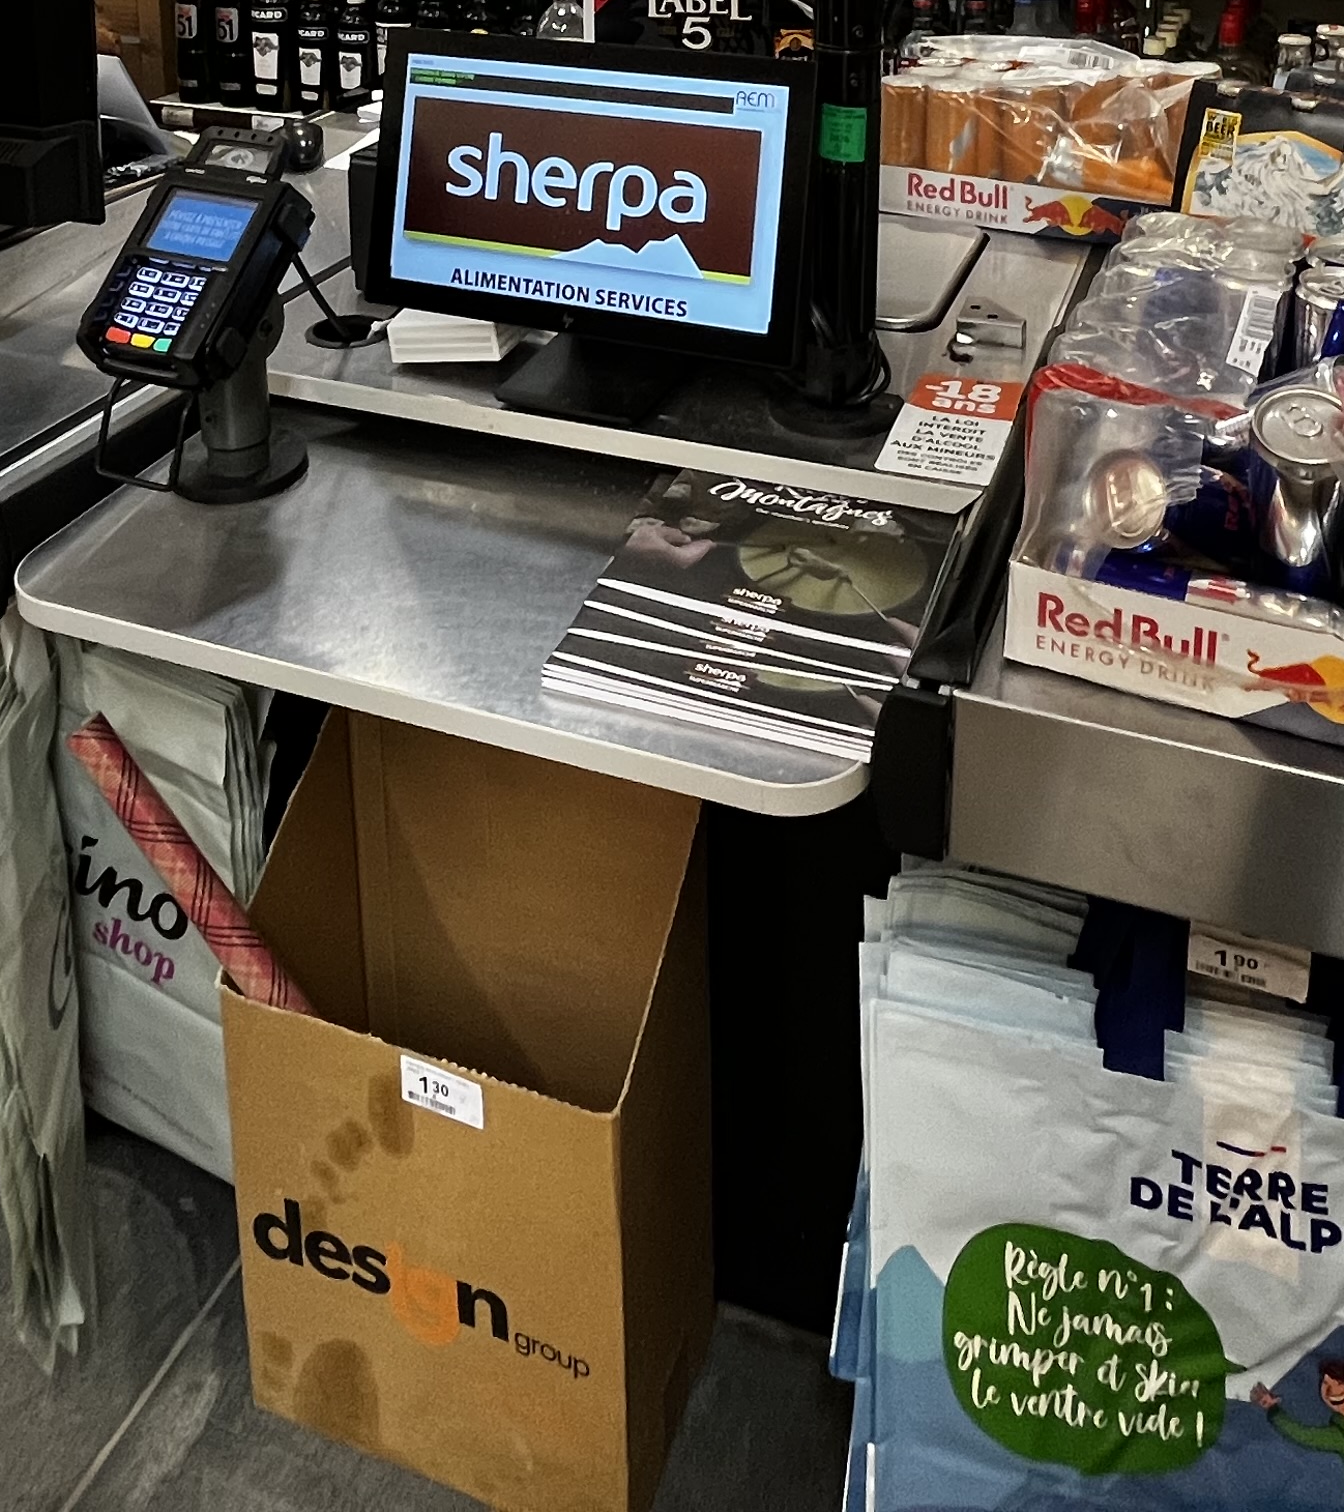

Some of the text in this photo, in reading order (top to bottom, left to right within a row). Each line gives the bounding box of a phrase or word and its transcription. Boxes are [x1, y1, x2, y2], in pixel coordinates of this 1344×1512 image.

[177, 16, 193, 38] 51
[252, 10, 282, 20] CARD
[218, 21, 234, 41] 51
[299, 29, 324, 38] CARD
[338, 32, 364, 42] CARD
[682, 16, 712, 50] 5
[1205, 121, 1236, 137] BEER
[446, 132, 708, 231] sherpa
[907, 172, 1009, 210] Red Bull
[906, 200, 1009, 225] ENERGY DRINK
[450, 268, 688, 318] ALIMENTATION SERVICES
[925, 380, 1002, 404] -18
[931, 396, 996, 414] ans
[918, 421, 987, 436] INTERDIT
[932, 415, 980, 427] LA LOI
[912, 435, 981, 451] D'ALCOOL
[916, 428, 984, 443] LA VENTE
[890, 439, 996, 461] AUX MINEURS
[732, 587, 784, 607] sherpa
[1037, 591, 1218, 666] Red Bull
[694, 662, 747, 683] sherpa
[1036, 634, 1216, 692] ENERGY DRINK
[75, 834, 189, 941] ino
[93, 916, 176, 986] shop
[1171, 1149, 1329, 1216] TERRE
[1129, 1176, 1195, 1222] DE
[1005, 1240, 1088, 1301] Règle
[1008, 1290, 1173, 1357] Ne jamais
[514, 1330, 590, 1379] group
[953, 1331, 1085, 1388] grimper
[1097, 1353, 1126, 1392] et
[1010, 1383, 1108, 1428] ventre
[1118, 1403, 1184, 1441] vide
